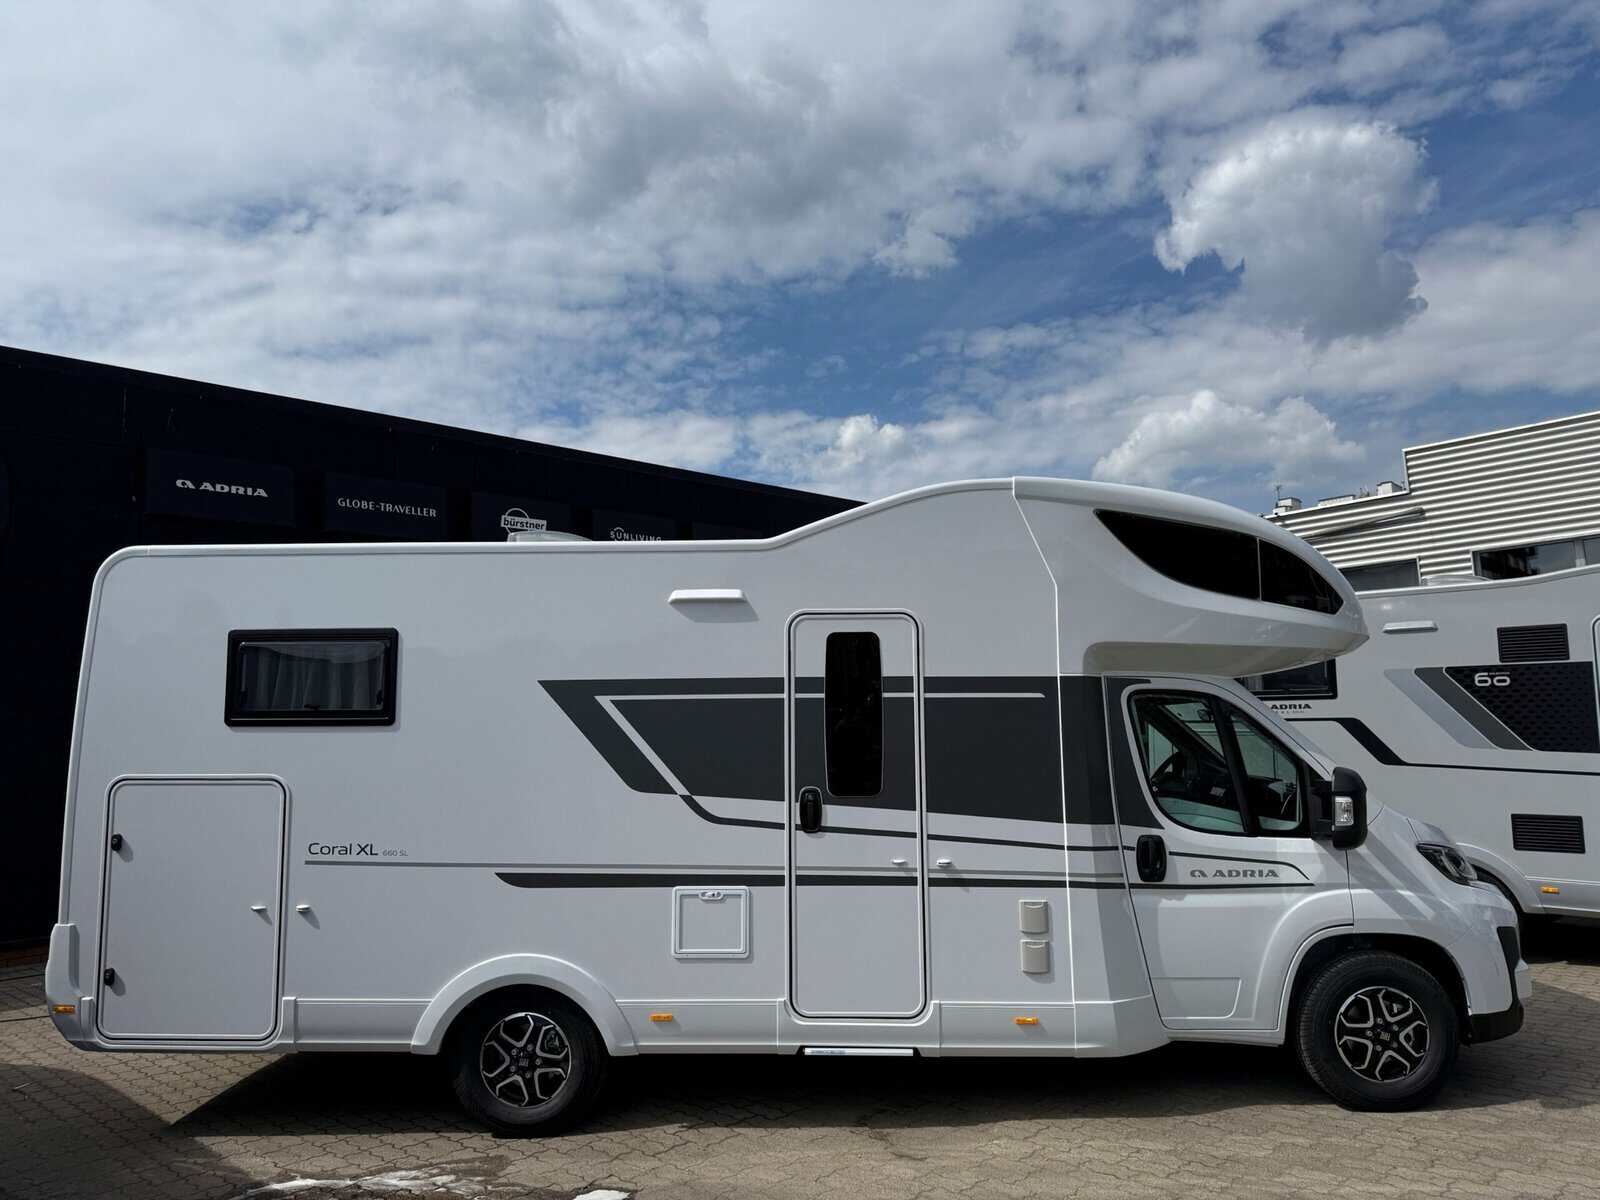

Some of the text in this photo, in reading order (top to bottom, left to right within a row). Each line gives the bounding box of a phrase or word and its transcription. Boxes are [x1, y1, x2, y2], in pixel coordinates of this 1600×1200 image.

[199, 482, 268, 498] ADRIA
[337, 497, 437, 518] GLOBE-TRAVELLER
[503, 516, 545, 530] bürstner
[308, 842, 352, 856] Coral
[356, 843, 379, 856] XL
[1212, 869, 1280, 878] ADRIA
